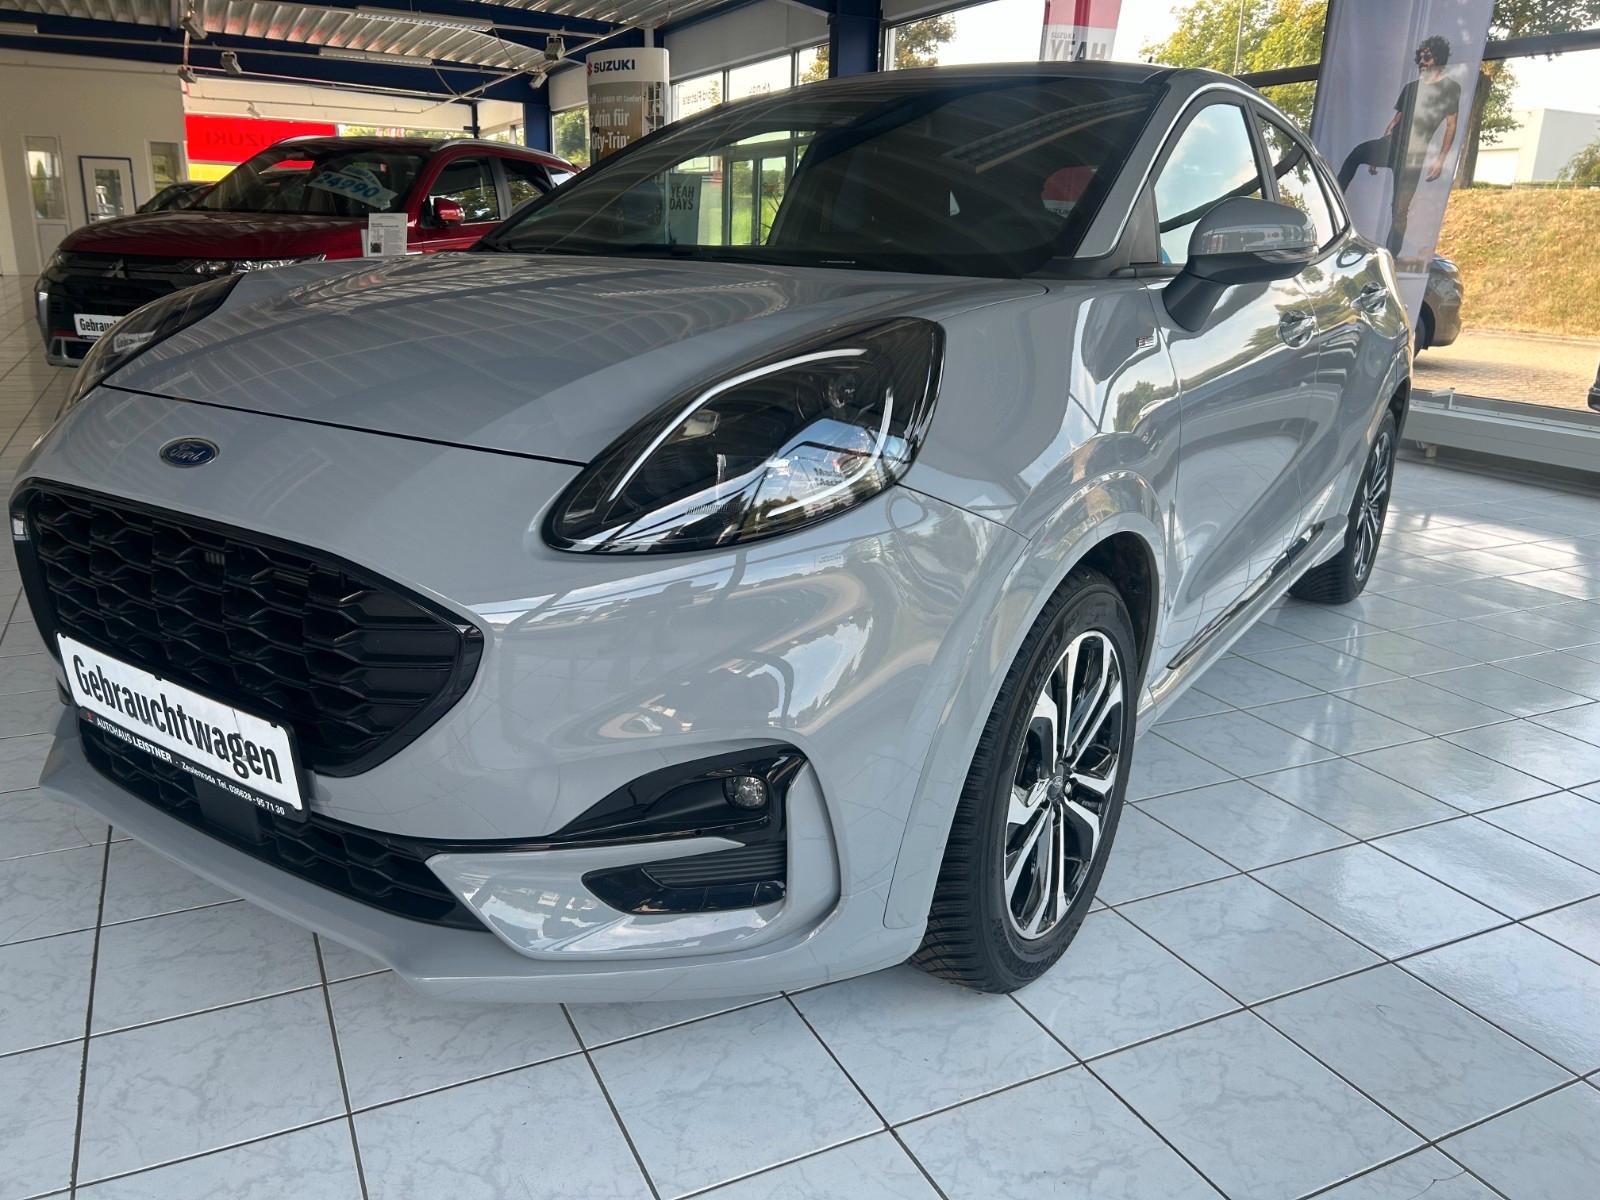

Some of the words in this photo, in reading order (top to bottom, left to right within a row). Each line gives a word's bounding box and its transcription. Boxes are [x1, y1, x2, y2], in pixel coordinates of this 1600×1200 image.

[593, 59, 635, 74] SUZUKI
[613, 108, 630, 127] für
[671, 185, 695, 198] YEAH
[669, 198, 694, 210] DAYS
[73, 654, 283, 784] Gebrauchtwagen
[96, 717, 133, 744] AUTOHAUS
[132, 736, 173, 764] LEISTNER
[216, 778, 230, 791] Tel.
